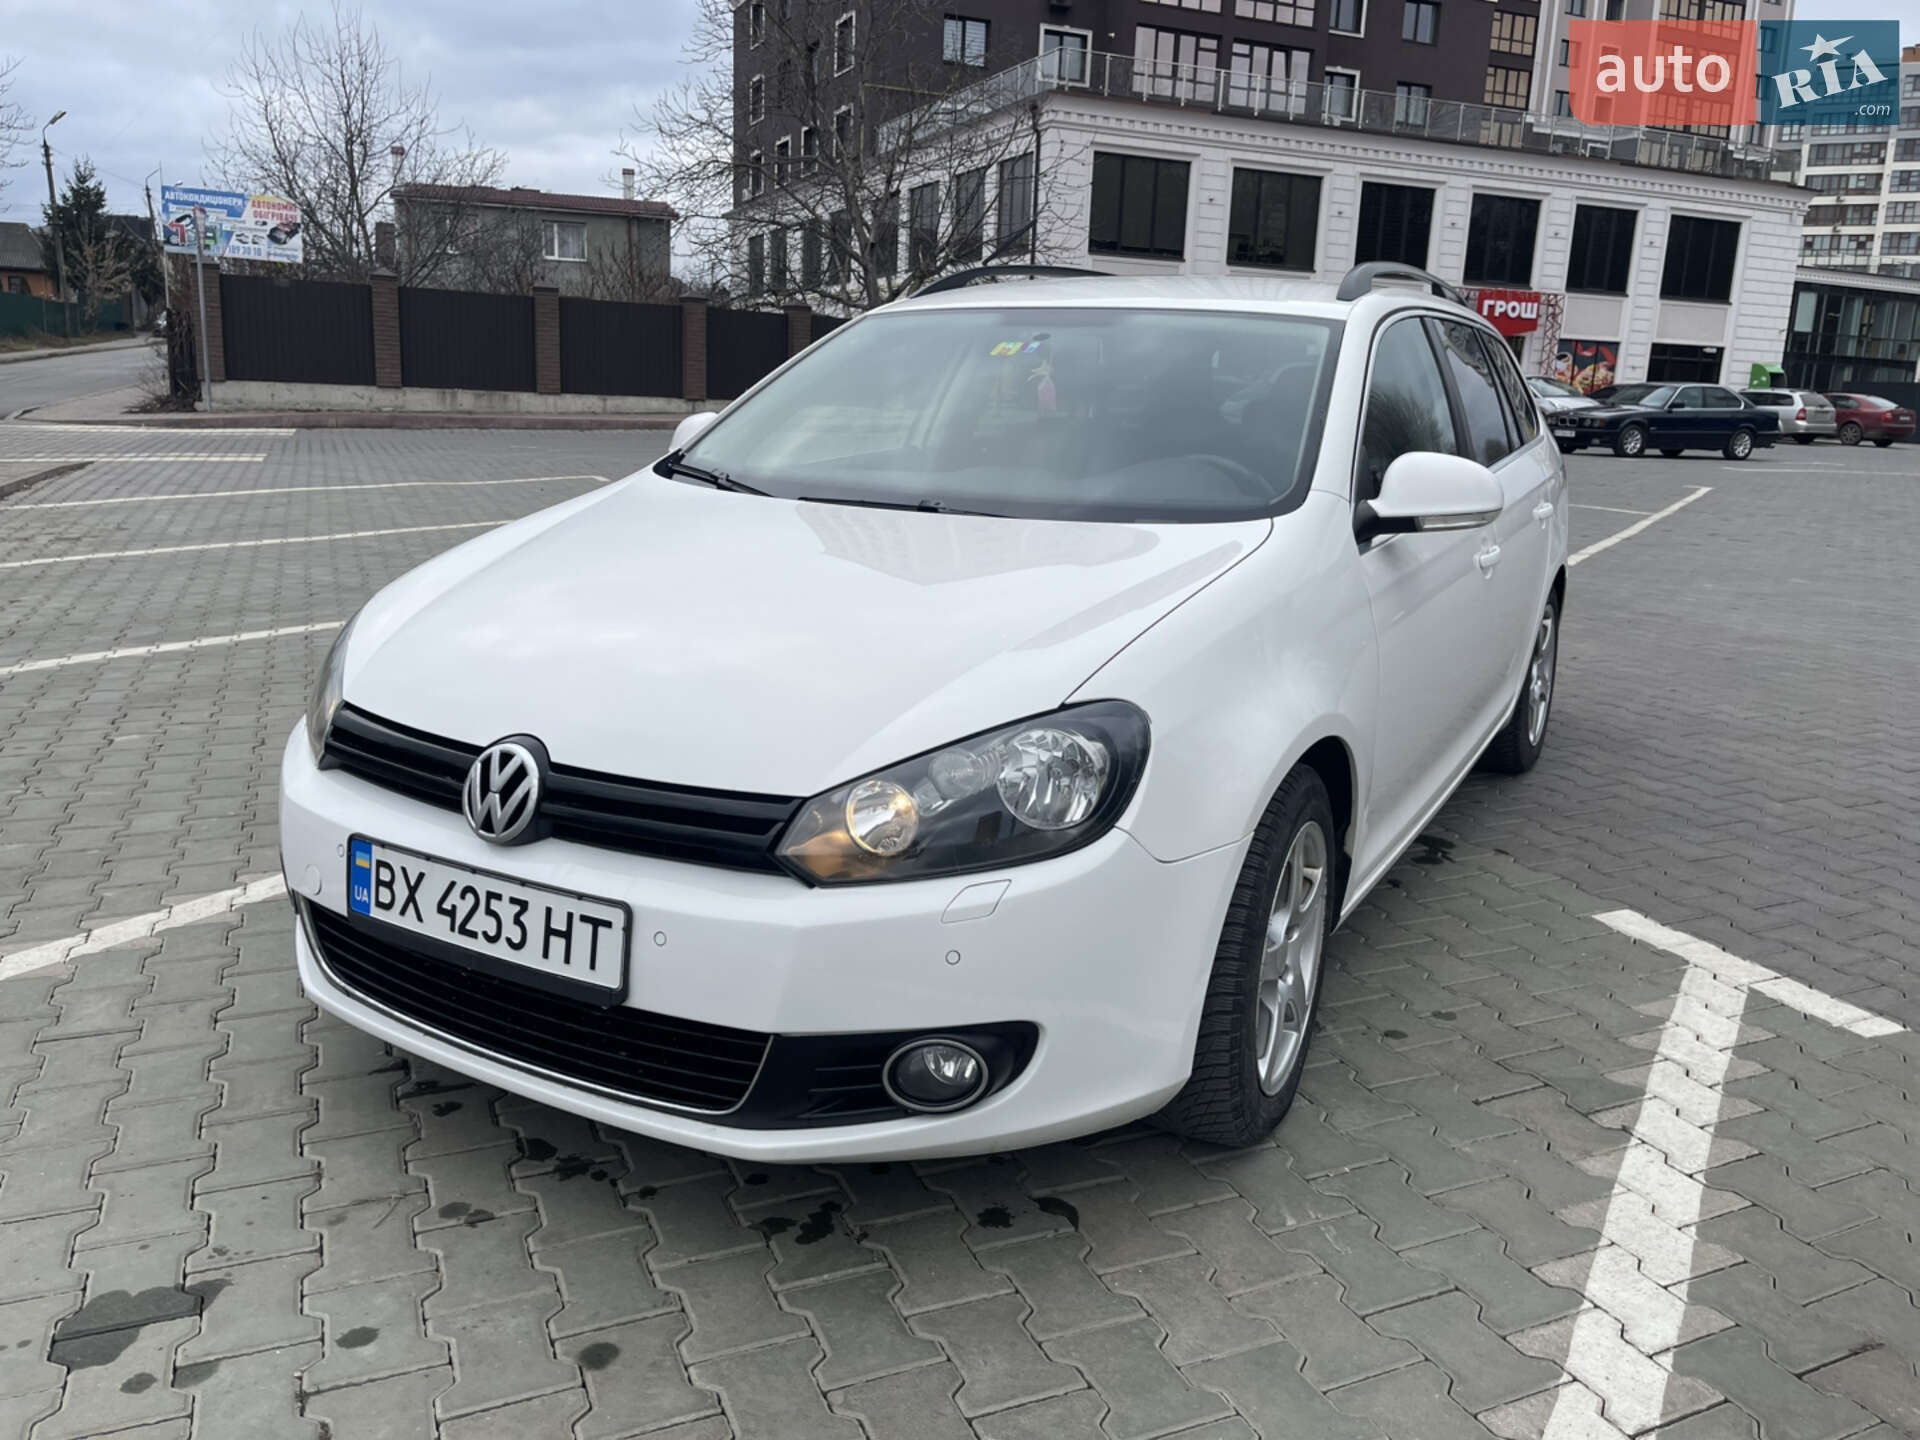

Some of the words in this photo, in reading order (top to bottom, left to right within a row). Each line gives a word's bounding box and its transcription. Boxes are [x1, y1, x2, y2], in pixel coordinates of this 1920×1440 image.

[1482, 299, 1539, 319] ГРОШ
[354, 885, 369, 904] UA
[375, 859, 426, 923] BX
[437, 880, 529, 951] 4253
[542, 906, 613, 971] HT
